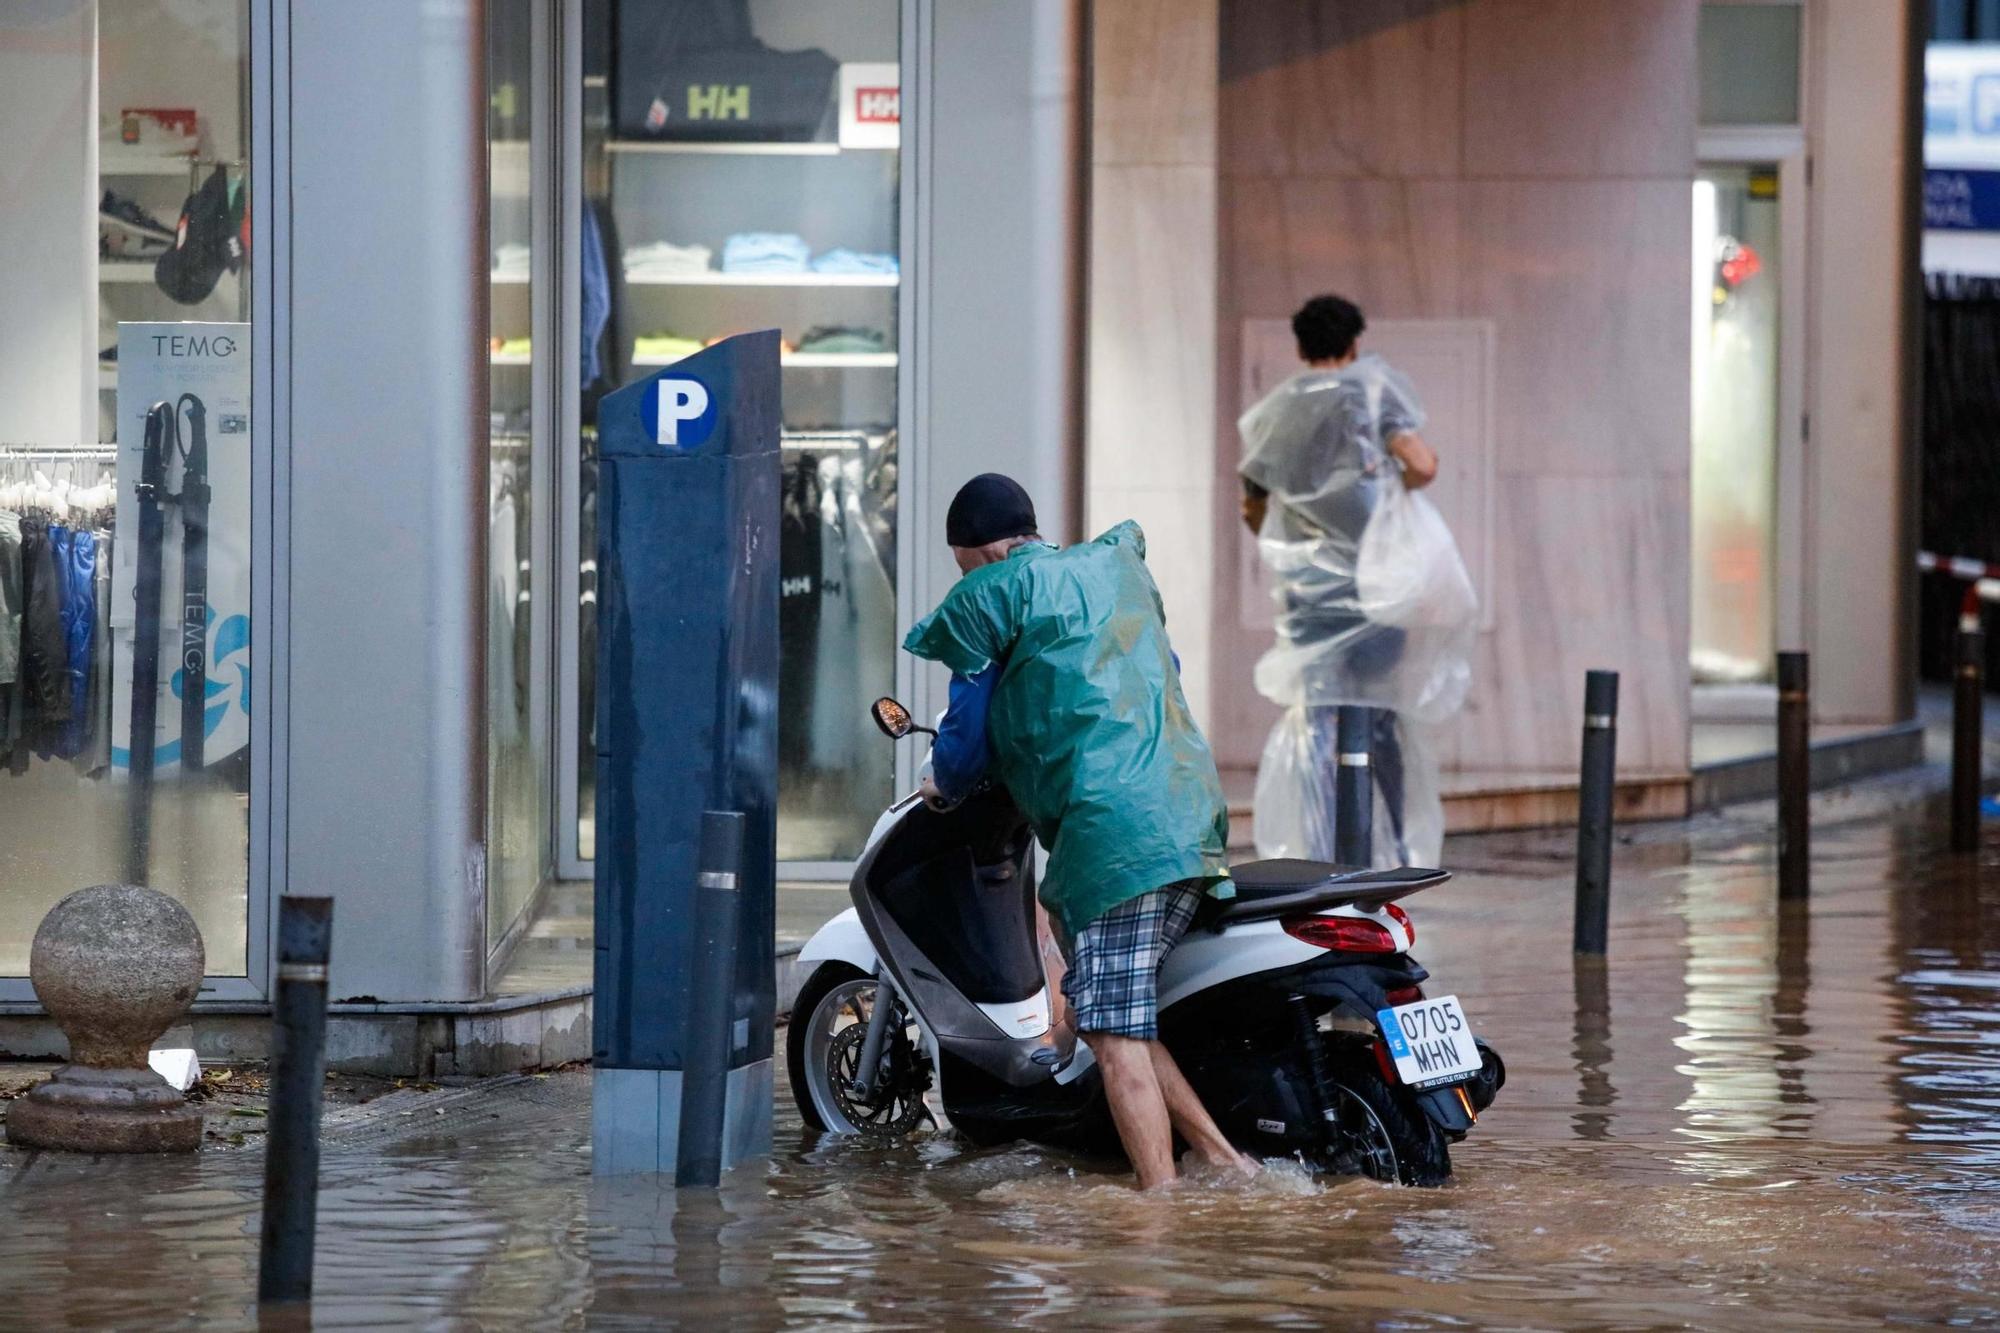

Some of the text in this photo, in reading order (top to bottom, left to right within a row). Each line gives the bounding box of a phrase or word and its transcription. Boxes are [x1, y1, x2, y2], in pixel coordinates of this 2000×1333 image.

[687, 85, 750, 120] HH
[657, 379, 708, 445] P
[782, 576, 811, 597] HH
[1400, 1003, 1461, 1040] 0705
[1411, 1036, 1462, 1073] MHN
